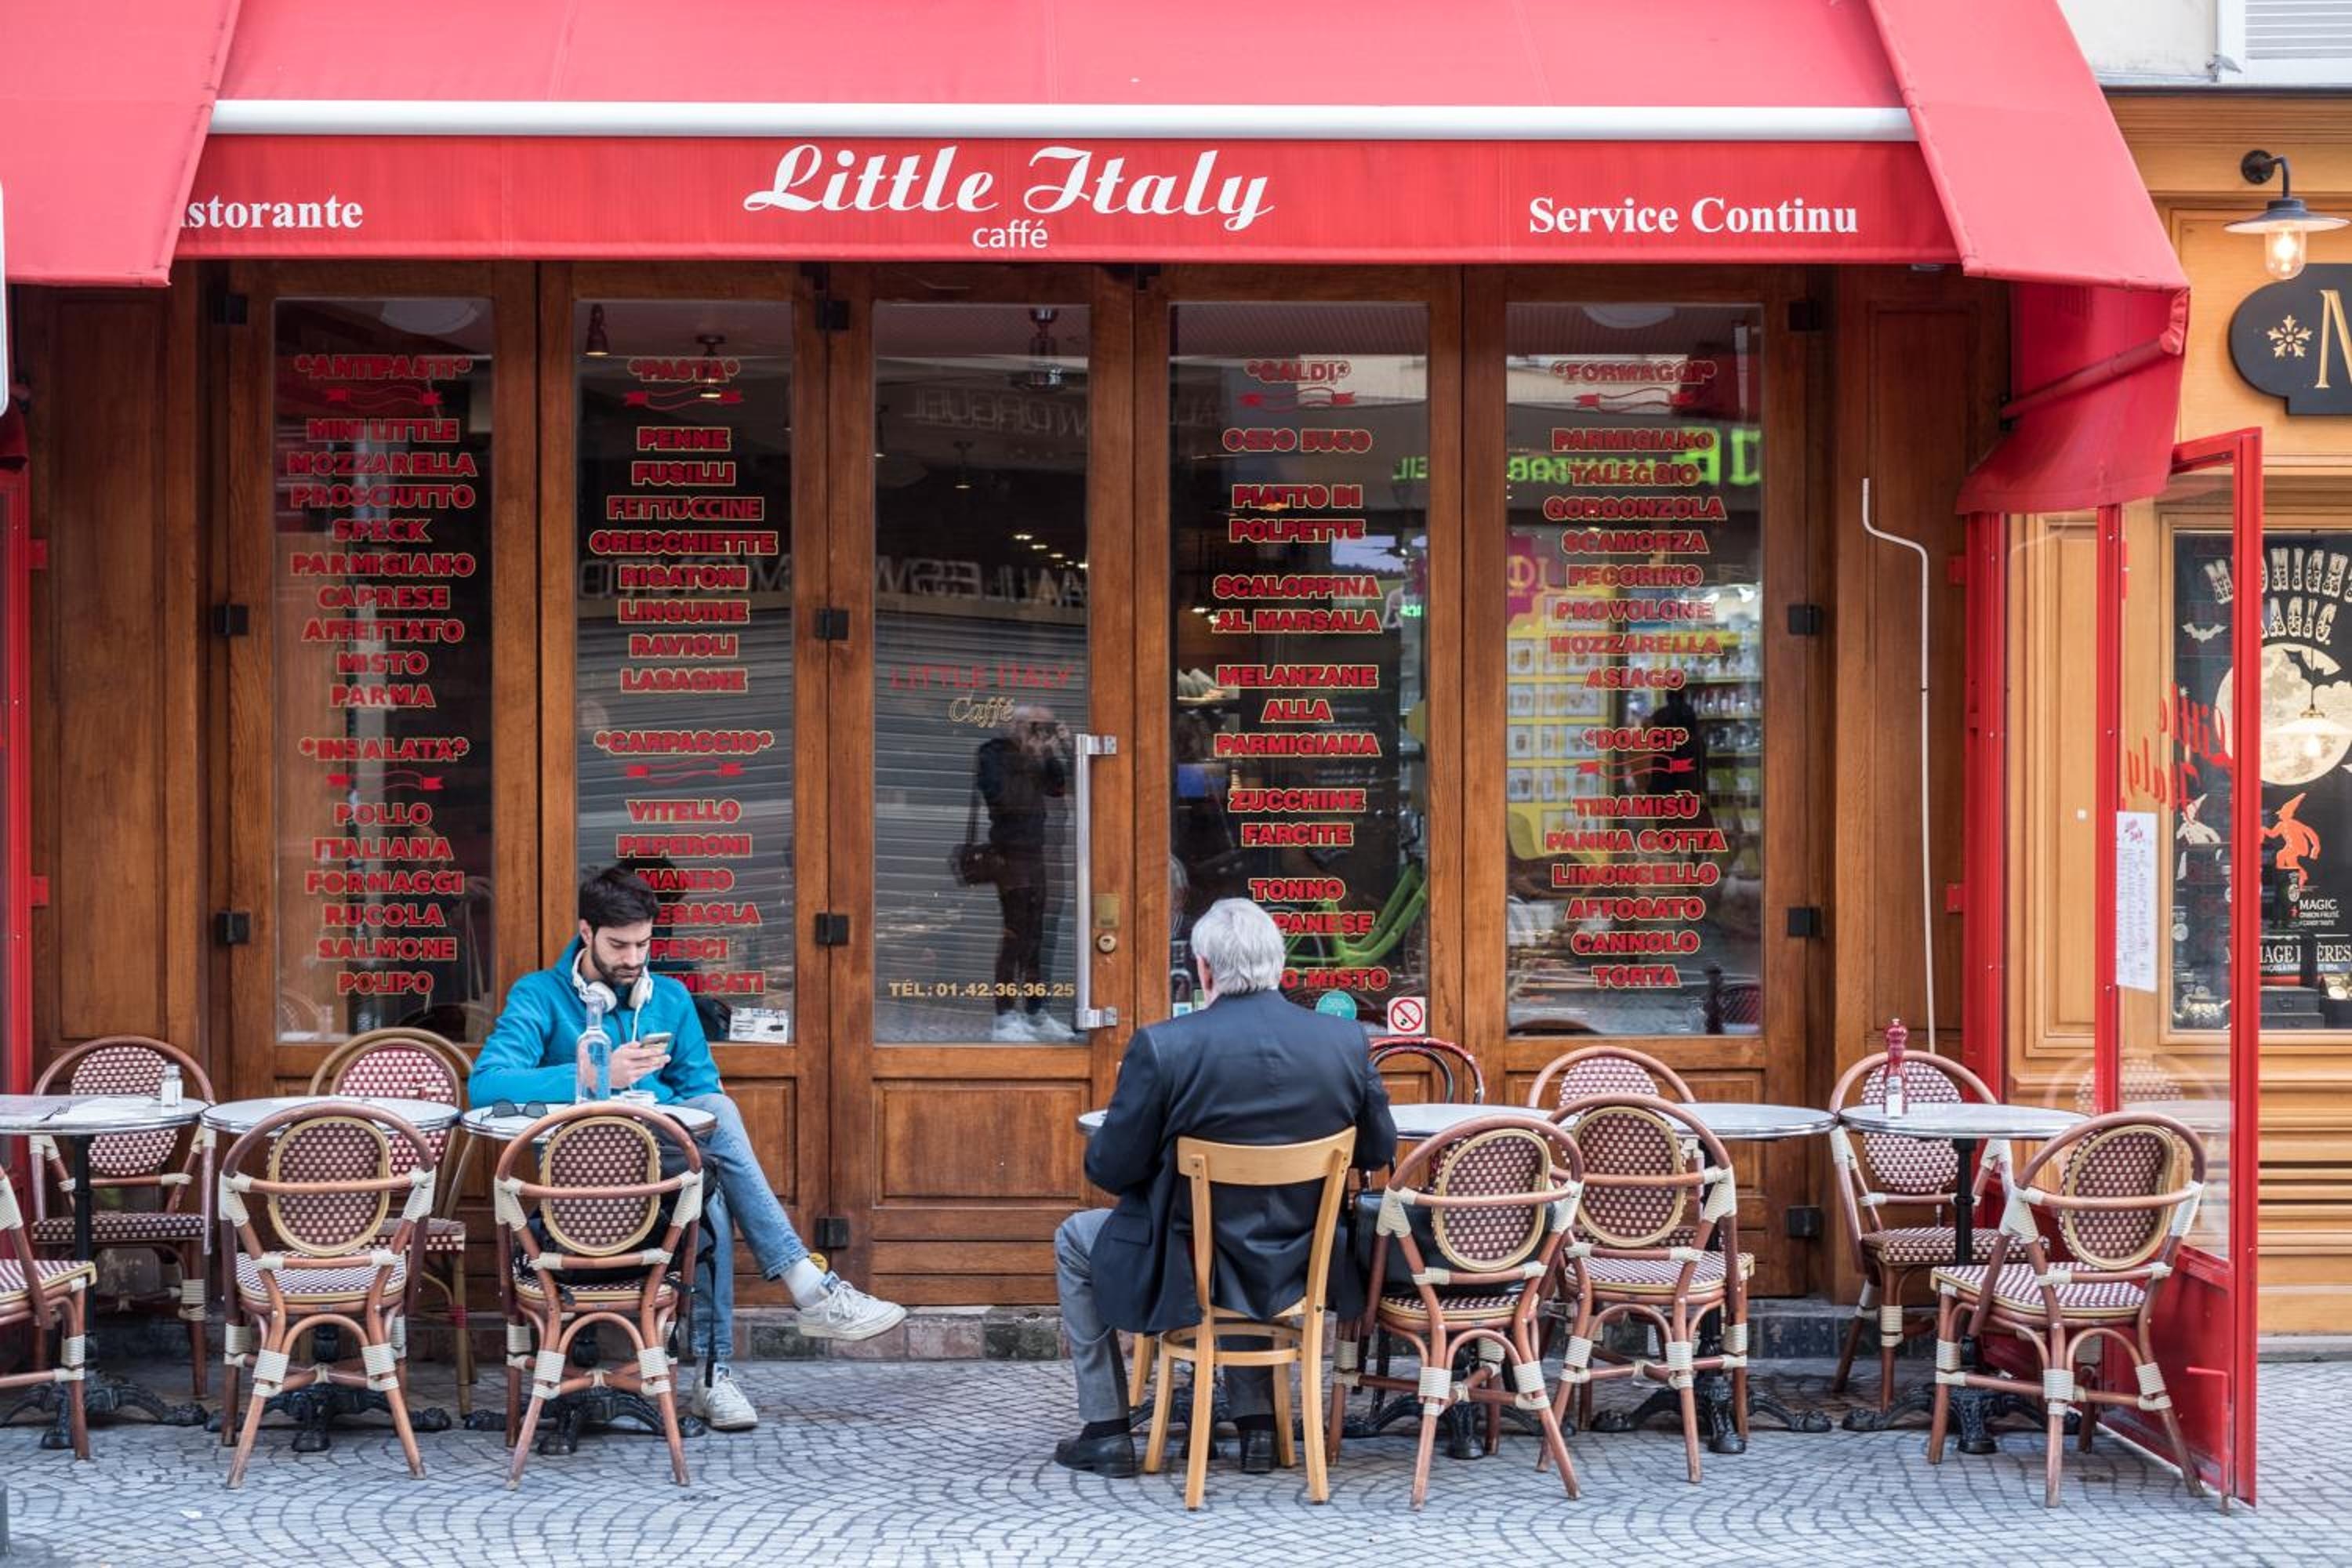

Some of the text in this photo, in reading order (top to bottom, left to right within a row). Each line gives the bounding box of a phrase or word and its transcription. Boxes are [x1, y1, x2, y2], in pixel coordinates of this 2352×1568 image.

[743, 143, 1276, 230] Little Italy
[180, 194, 363, 228] storante
[1530, 197, 1858, 234] Service Continu
[973, 220, 1048, 249] caffé
[307, 419, 459, 442] MINI LITTLE
[637, 426, 731, 452] PENNE
[1223, 428, 1371, 452] OSSO BUCO
[1552, 428, 1719, 452] PARMIGIANO
[287, 452, 477, 477] MOZZARELLA
[631, 461, 735, 486] FUSILLI
[1568, 463, 1700, 486] TALEGGIO
[290, 484, 475, 508] PROSCIUTTO
[607, 495, 764, 521] FETTUCCINE
[1232, 484, 1329, 508] PIATTO
[1544, 496, 1727, 520] GORGONZOLA
[332, 519, 432, 542] SPECK
[590, 530, 778, 555] ORECCHIETTE
[1229, 518, 1366, 543] POLPETTE
[1562, 530, 1710, 554] SCAMORZA
[290, 552, 475, 576] PARMIGIANO
[1566, 564, 1703, 587] PECORINO
[619, 564, 748, 590] RIGATONI
[1214, 574, 1383, 599] SCALOPPINA
[317, 585, 450, 609] CAPRESE
[619, 599, 750, 624] LINGUINE
[1212, 610, 1251, 633] AL
[1254, 610, 1383, 633] MARSALA
[1554, 599, 1716, 622] PROVOLONE
[302, 618, 465, 642] AFFETTATO
[629, 633, 738, 659] RAVIOLI
[1548, 633, 1724, 655] MOZZARELLA
[337, 652, 428, 674] MISTO
[621, 668, 748, 692] LASAGNE
[888, 663, 1074, 690] LITTLE ITALY
[1217, 665, 1378, 688] MELANZANE
[1582, 667, 1686, 690] ASIAGO
[330, 684, 436, 707] PARMA
[1261, 699, 1334, 723] ALLA
[1214, 732, 1382, 757] PARMIGIANA
[626, 799, 740, 823] VITELLO
[1229, 788, 1366, 812] ZUCCHINE
[1573, 790, 1700, 818] TIRAMISÙ
[334, 803, 432, 826] POLLO
[616, 834, 752, 858] PEPERONI
[1241, 823, 1353, 847] FARCITE
[1544, 828, 1728, 852] PANNA COTTA
[314, 837, 452, 861] ITALIANA
[306, 870, 464, 894] FORMAGGI
[635, 869, 735, 893] MANZO
[1552, 863, 1720, 887] LIMONCELLO
[1249, 878, 1345, 902] TONNO
[324, 903, 445, 927] RUCOLA
[653, 902, 762, 927] ESAOLA
[1565, 897, 1705, 921] AFFOGATO
[2299, 899, 2337, 910] MAGIC
[1272, 911, 1375, 935] PANESE
[317, 938, 456, 960] SALMONE
[651, 938, 728, 960] PESCI
[1572, 930, 1700, 955] CANNOLO
[337, 971, 434, 995] POLIPO
[1304, 967, 1390, 990] MISTO
[1592, 964, 1681, 988] TORTA
